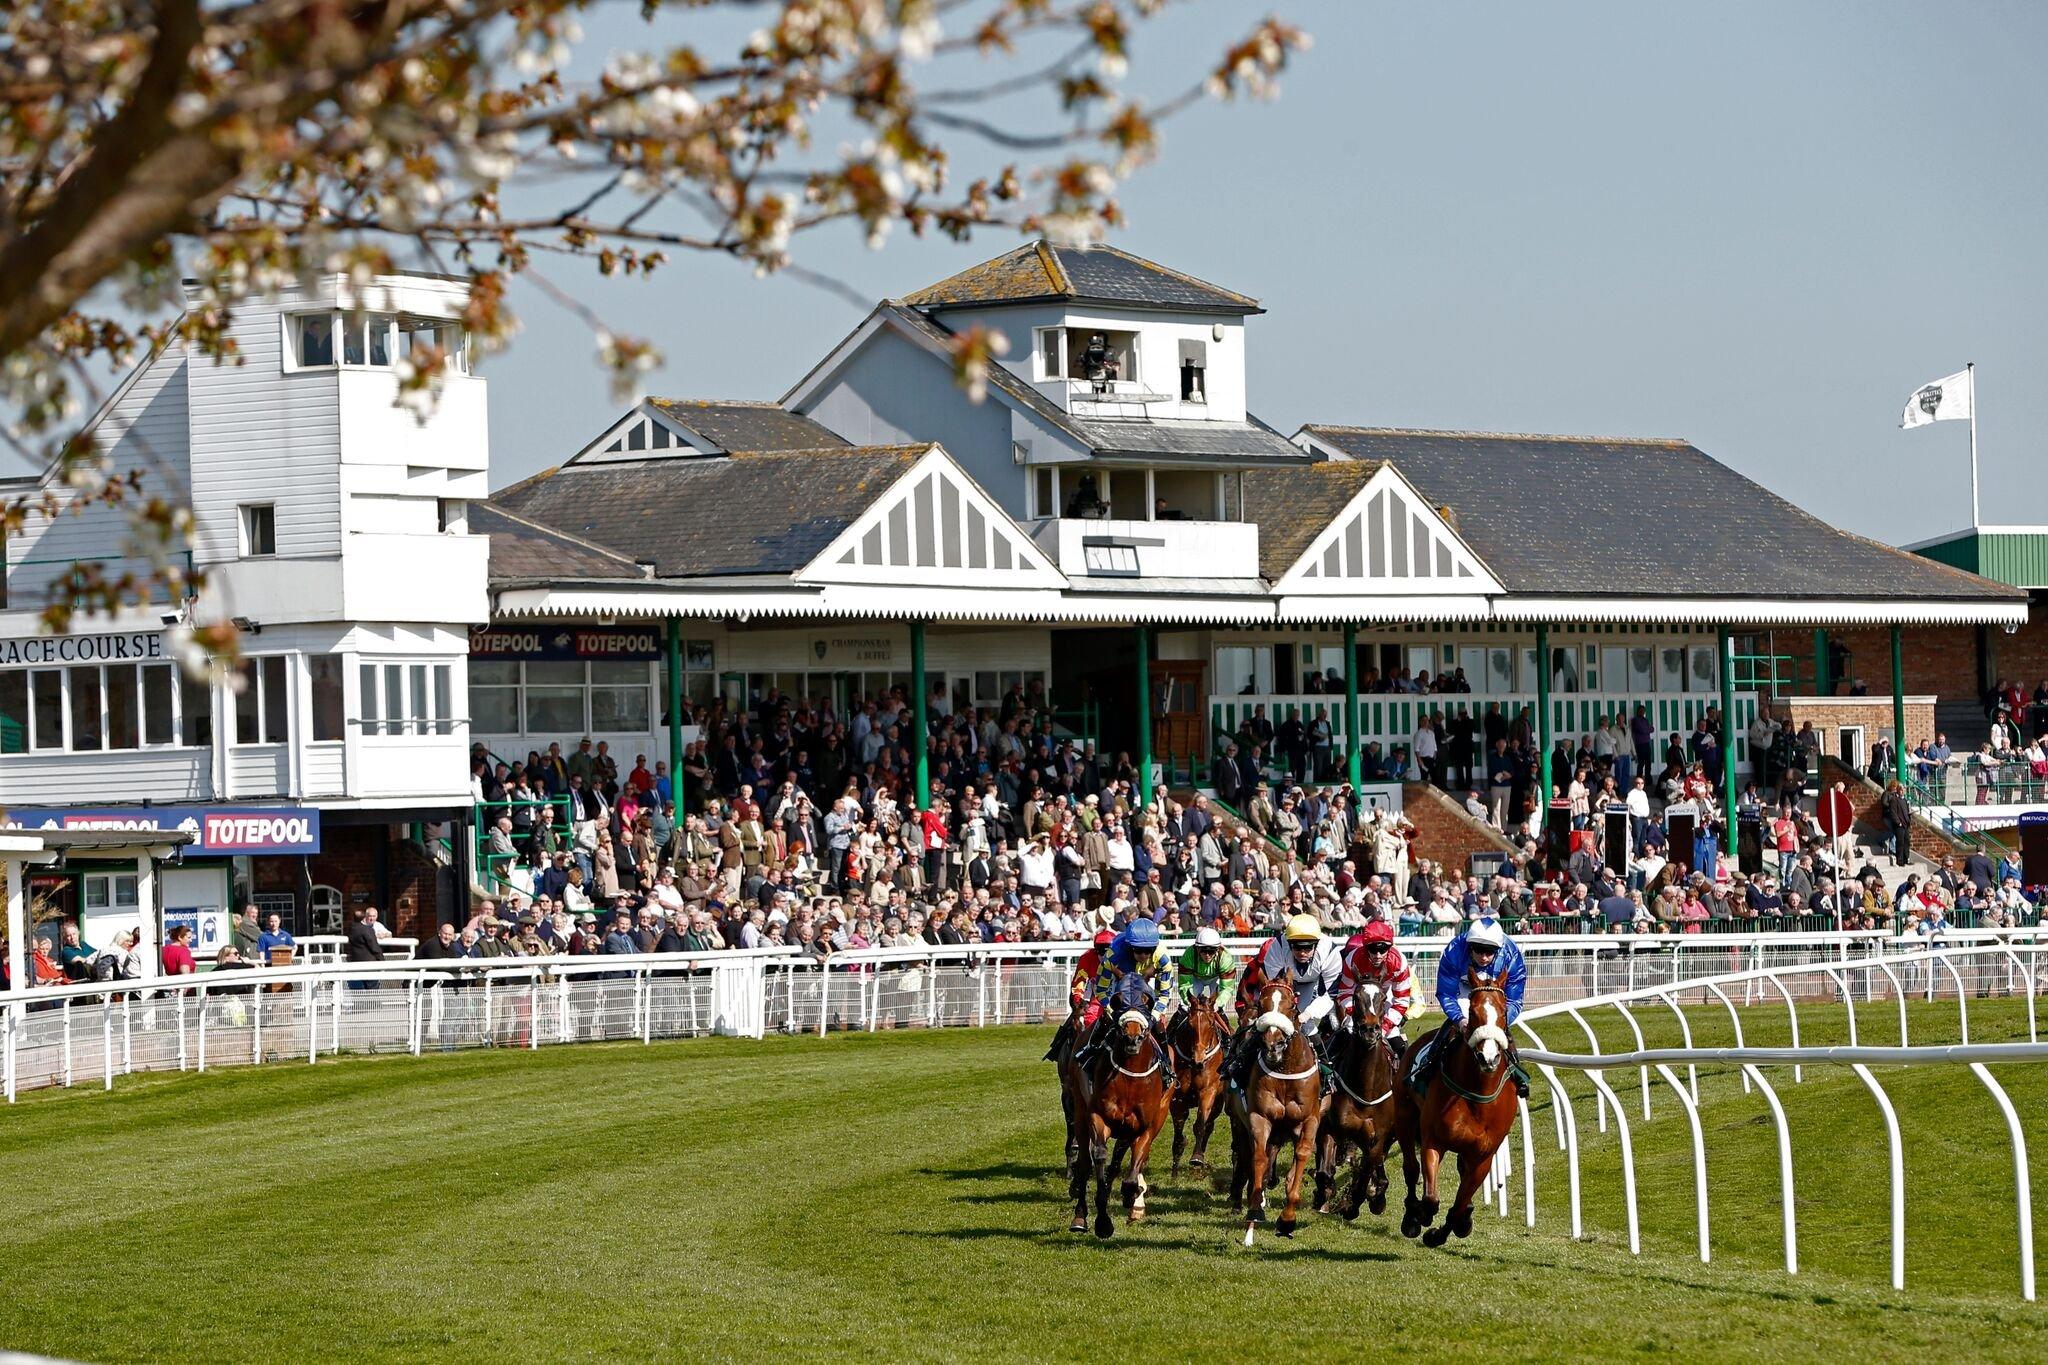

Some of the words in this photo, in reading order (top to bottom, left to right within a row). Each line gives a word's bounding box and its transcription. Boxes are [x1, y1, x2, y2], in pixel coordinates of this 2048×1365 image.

[470, 633, 542, 652] OTEPOOL
[578, 634, 657, 652] TOTEPOOL
[207, 817, 314, 844] TOTEPOOL
